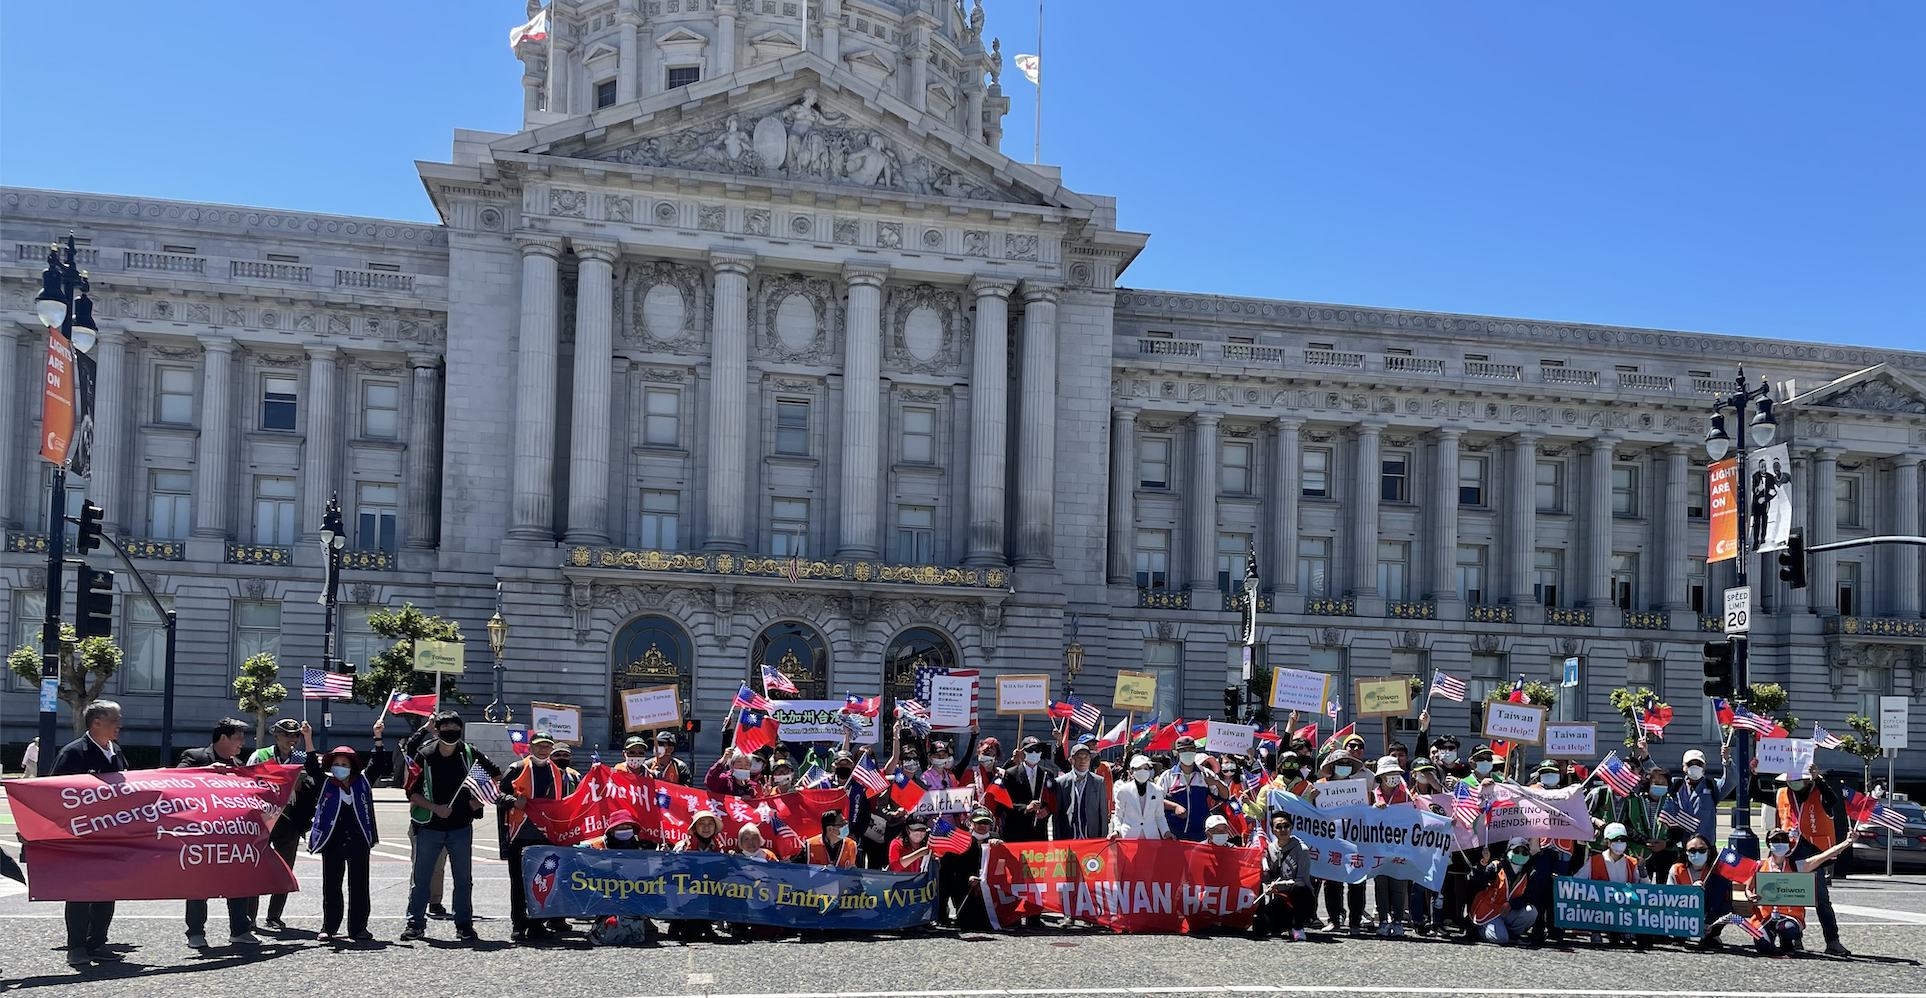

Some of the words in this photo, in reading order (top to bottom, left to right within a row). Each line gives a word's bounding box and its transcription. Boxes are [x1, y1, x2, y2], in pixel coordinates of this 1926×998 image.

[49, 336, 73, 362] LIGHTS
[48, 355, 64, 374] ARE
[47, 372, 60, 388] ON
[1711, 466, 1738, 482] LIGHT
[1712, 482, 1730, 496] ARE
[1712, 497, 1726, 509] ON
[1727, 592, 1748, 602] SPEED
[1729, 602, 1746, 610] LIMIT
[1728, 610, 1747, 627] 20
[1497, 709, 1533, 723] Taiwan
[1217, 728, 1246, 738] Taiwan
[1492, 724, 1508, 733] Can
[1510, 726, 1534, 737] Help!!
[1553, 730, 1588, 739] Taiwan
[1551, 743, 1566, 751] Can
[1567, 743, 1590, 752] Help!!
[1763, 743, 1777, 751] Let
[1779, 744, 1808, 753] Taiwan
[1764, 755, 1785, 764] Help
[61, 777, 196, 809] Sacramento
[1324, 786, 1357, 796] Taiwan
[1350, 798, 1365, 806] Go!
[70, 796, 207, 837] Emergency
[1488, 818, 1541, 830] FRIENDSHIP
[584, 815, 610, 834] Hak
[1342, 818, 1408, 845] Volunteer
[1411, 823, 1451, 857] Group
[179, 843, 261, 871] (STEAA)
[1022, 849, 1076, 864] Health
[1022, 864, 1047, 878] for
[1052, 863, 1076, 878] All
[571, 871, 667, 899] Support
[672, 873, 770, 902] Taiwan's
[776, 883, 835, 914] Entry
[839, 889, 877, 909] into
[883, 878, 937, 909] WHO!
[1056, 881, 1172, 916] TAIWAN
[1183, 882, 1256, 916] HELP
[1557, 880, 1600, 903] WHA
[1604, 886, 1631, 905] For
[1635, 888, 1700, 909] Taiwan
[1556, 902, 1614, 925] Taiwan
[1619, 907, 1633, 926] is
[1637, 908, 1700, 936] Helping
